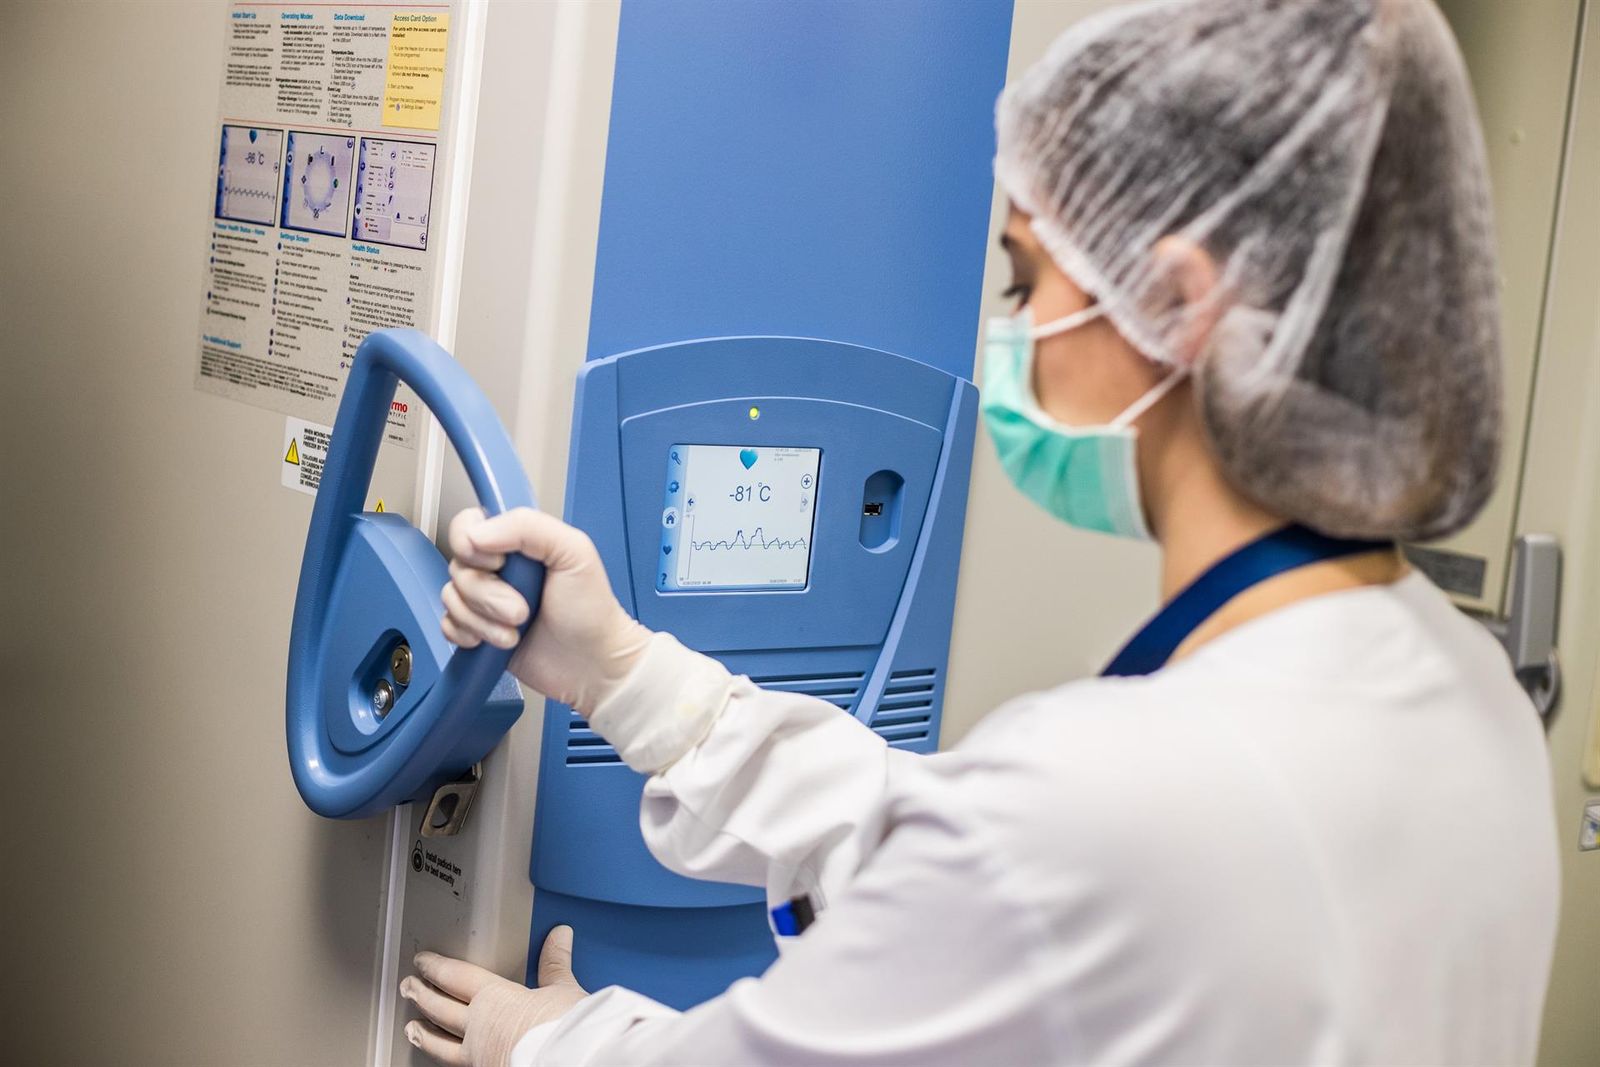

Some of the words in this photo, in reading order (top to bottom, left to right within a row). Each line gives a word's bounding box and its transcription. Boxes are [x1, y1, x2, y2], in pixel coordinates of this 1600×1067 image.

[282, 12, 300, 20] Operating
[422, 16, 437, 24] Option
[280, 232, 295, 241] Settings
[296, 234, 309, 242] Screen
[352, 244, 366, 252] Health
[366, 246, 380, 254] Status
[391, 401, 408, 412] rmo
[303, 441, 316, 449] FREEZER
[729, 486, 752, 502] -81
[425, 850, 437, 862] Install
[438, 857, 452, 870] padlock
[452, 864, 461, 876] here
[431, 865, 439, 878] best
[439, 871, 455, 887] security
